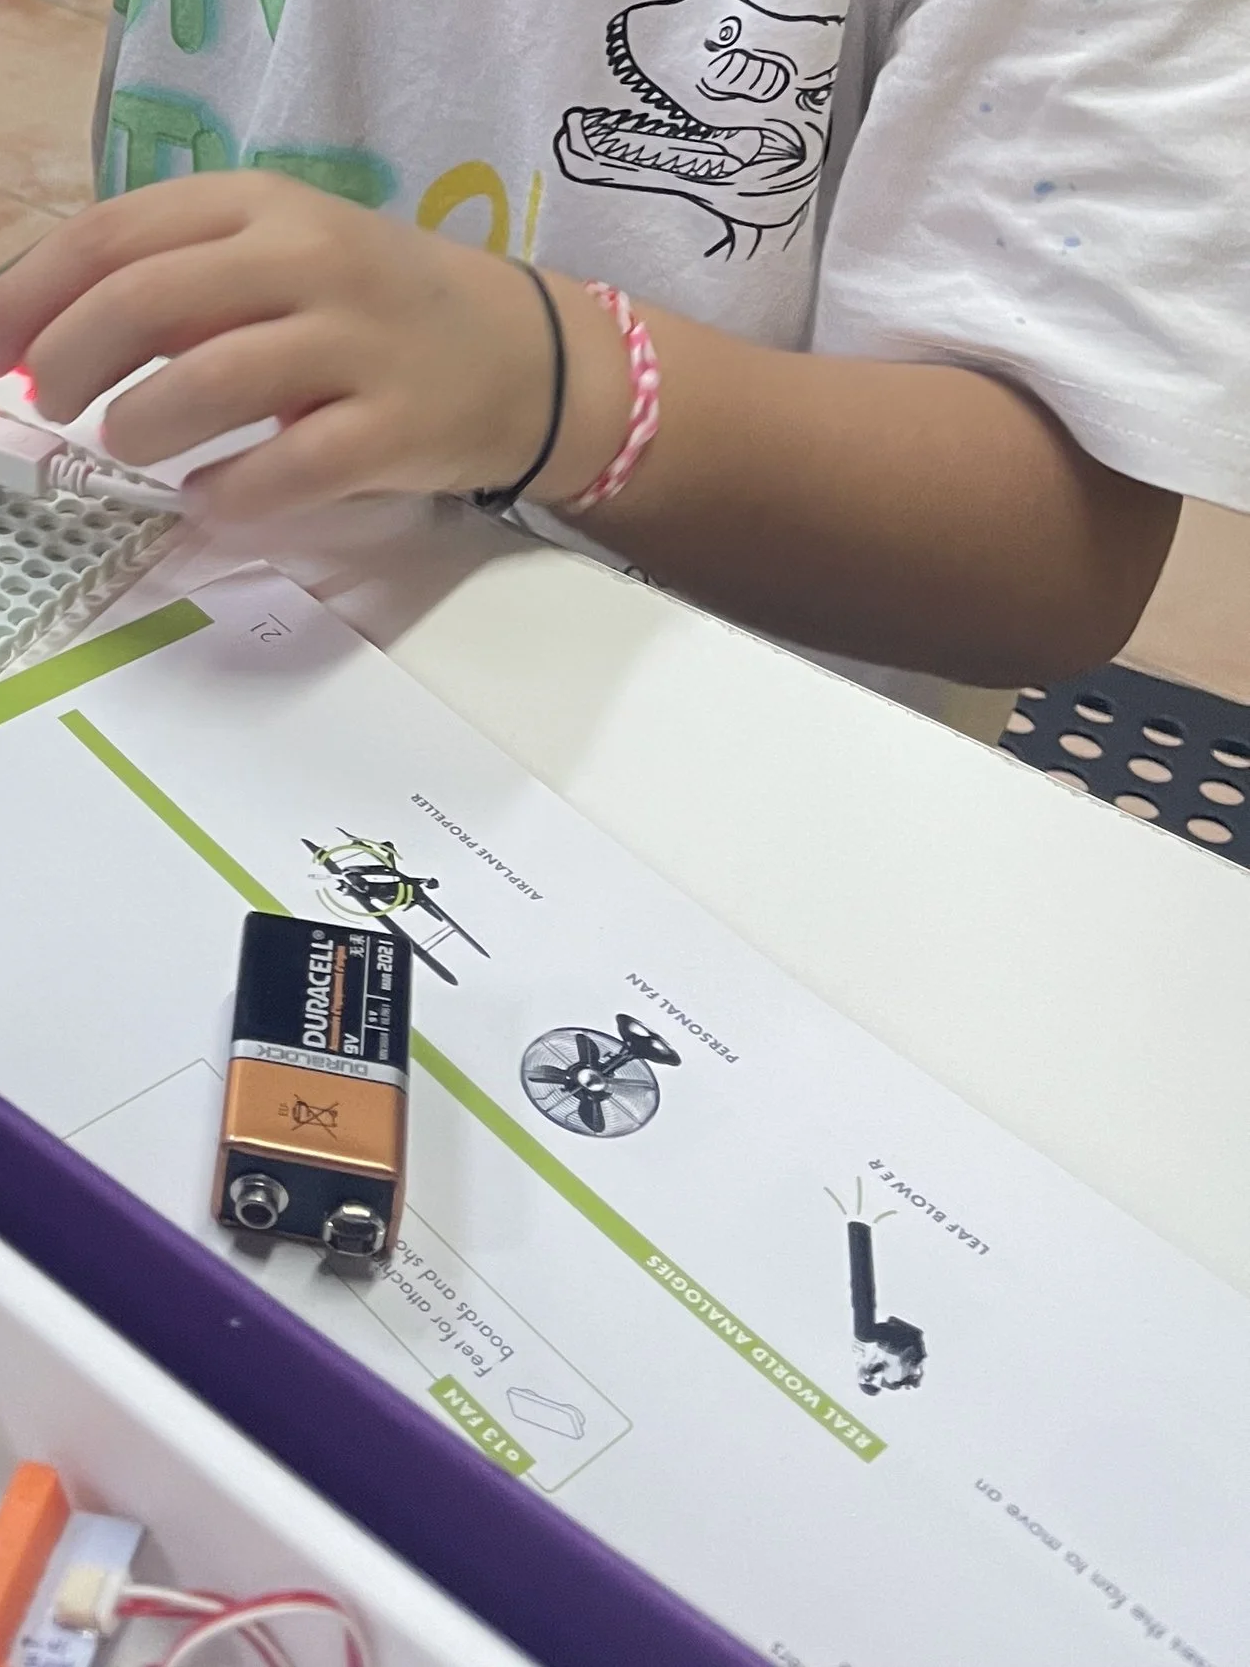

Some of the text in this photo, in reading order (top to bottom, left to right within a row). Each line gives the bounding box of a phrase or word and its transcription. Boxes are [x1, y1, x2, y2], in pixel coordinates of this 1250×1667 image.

[410, 793, 544, 901] AIRPLANE PROPELLER
[377, 939, 394, 972] 2021
[302, 939, 334, 1049] DURACELL
[625, 972, 740, 1064] PERSONAL FAN
[343, 1033, 360, 1056] 9V
[945, 1223, 990, 1256] LEAF
[417, 1269, 457, 1300] and
[431, 1314, 458, 1343] for
[456, 1302, 514, 1362] boards
[453, 1340, 493, 1378] Feet
[646, 1254, 872, 1449] REAL WORLD ANALOGIES
[442, 1388, 484, 1427] FAN
[975, 1477, 1002, 1503] on
[1006, 1502, 1063, 1552] move
